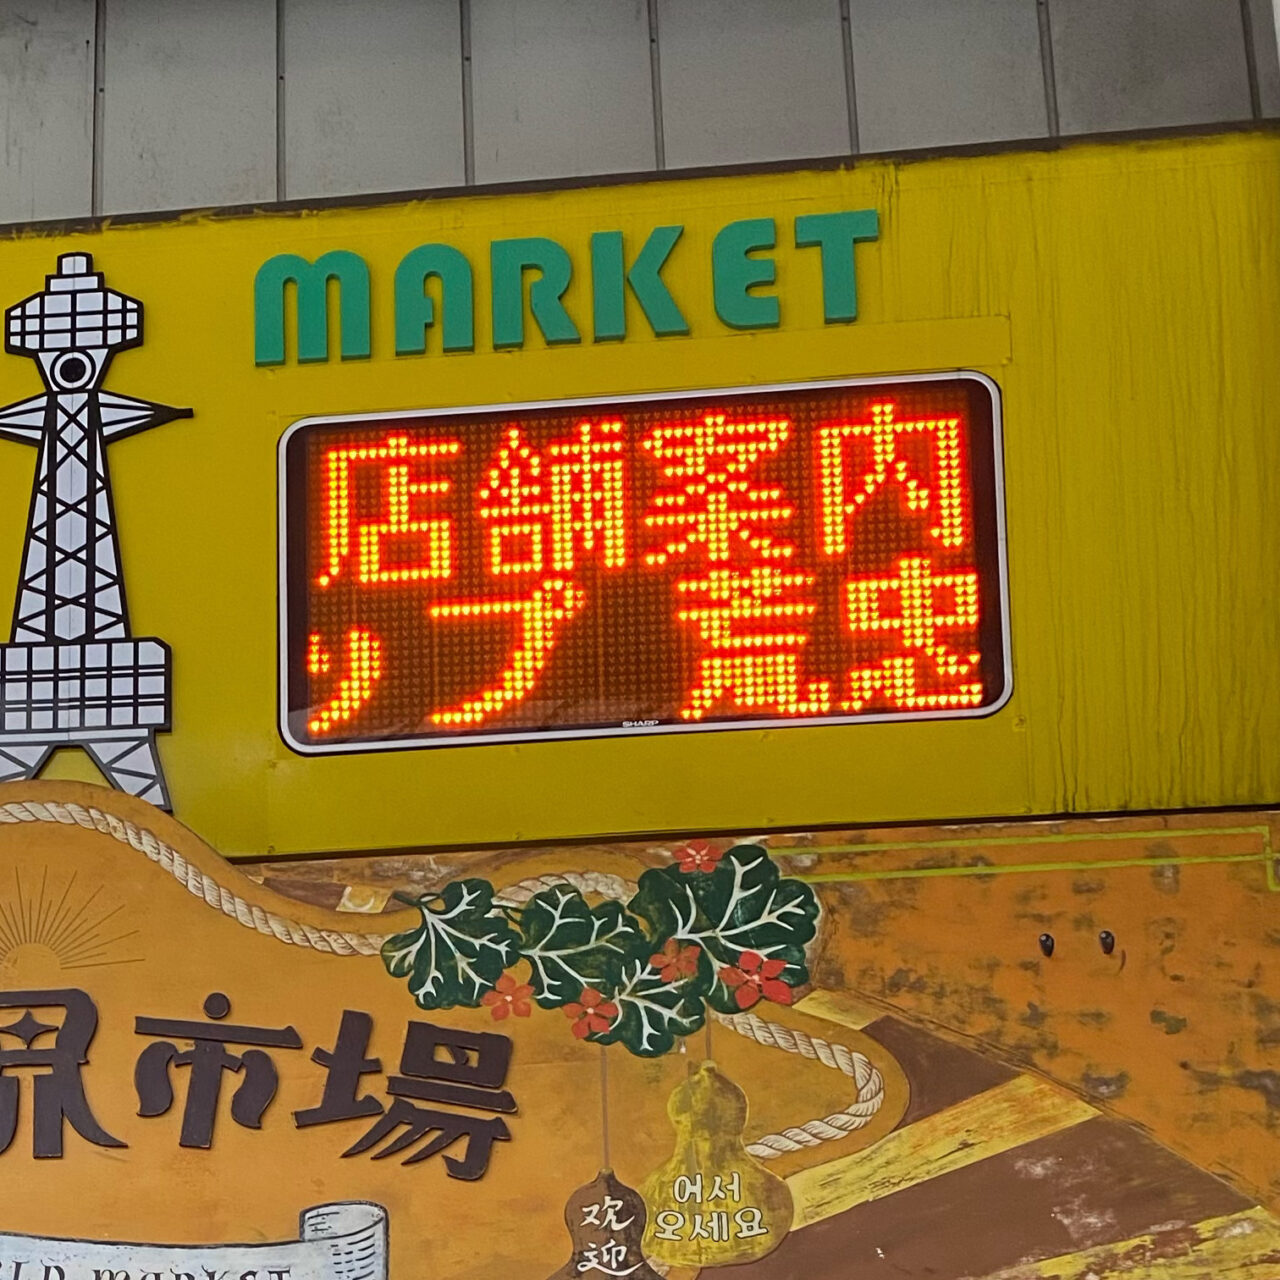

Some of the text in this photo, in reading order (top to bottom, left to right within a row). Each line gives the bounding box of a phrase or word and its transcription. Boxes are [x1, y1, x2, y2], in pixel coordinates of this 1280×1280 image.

[254, 208, 879, 367] MARKET
[316, 402, 966, 588] 店舗案内
[622, 719, 660, 729] SHARP
[672, 1171, 743, 1204] 어서
[653, 1207, 770, 1243] 오세요
